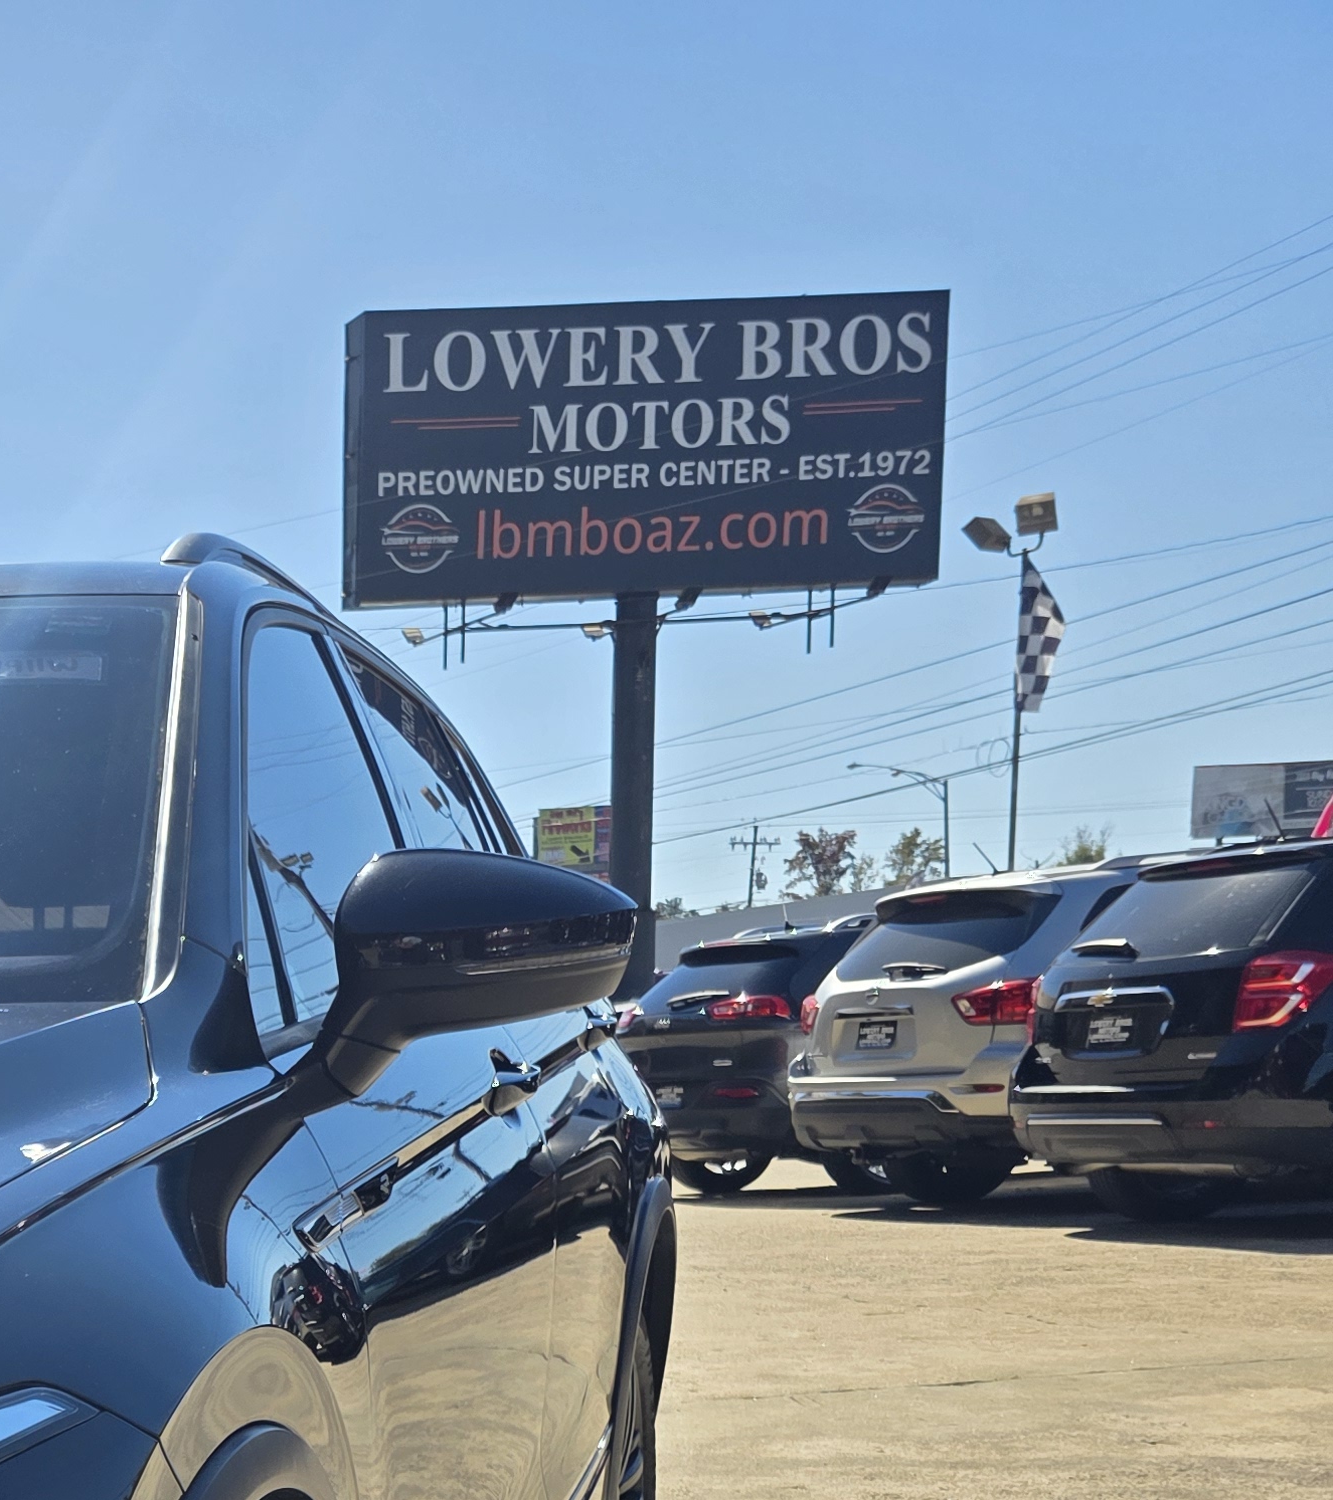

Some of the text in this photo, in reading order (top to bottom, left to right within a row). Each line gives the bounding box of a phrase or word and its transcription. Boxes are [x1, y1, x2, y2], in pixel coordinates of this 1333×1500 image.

[382, 312, 932, 393] LOWERY BROS
[528, 395, 791, 454] MOTORS
[378, 467, 544, 497] PREOWNED
[553, 462, 651, 491] SUPER
[659, 458, 771, 488] CENTER
[798, 449, 932, 481] EST.1972
[476, 506, 828, 559] lbmboaz.com
